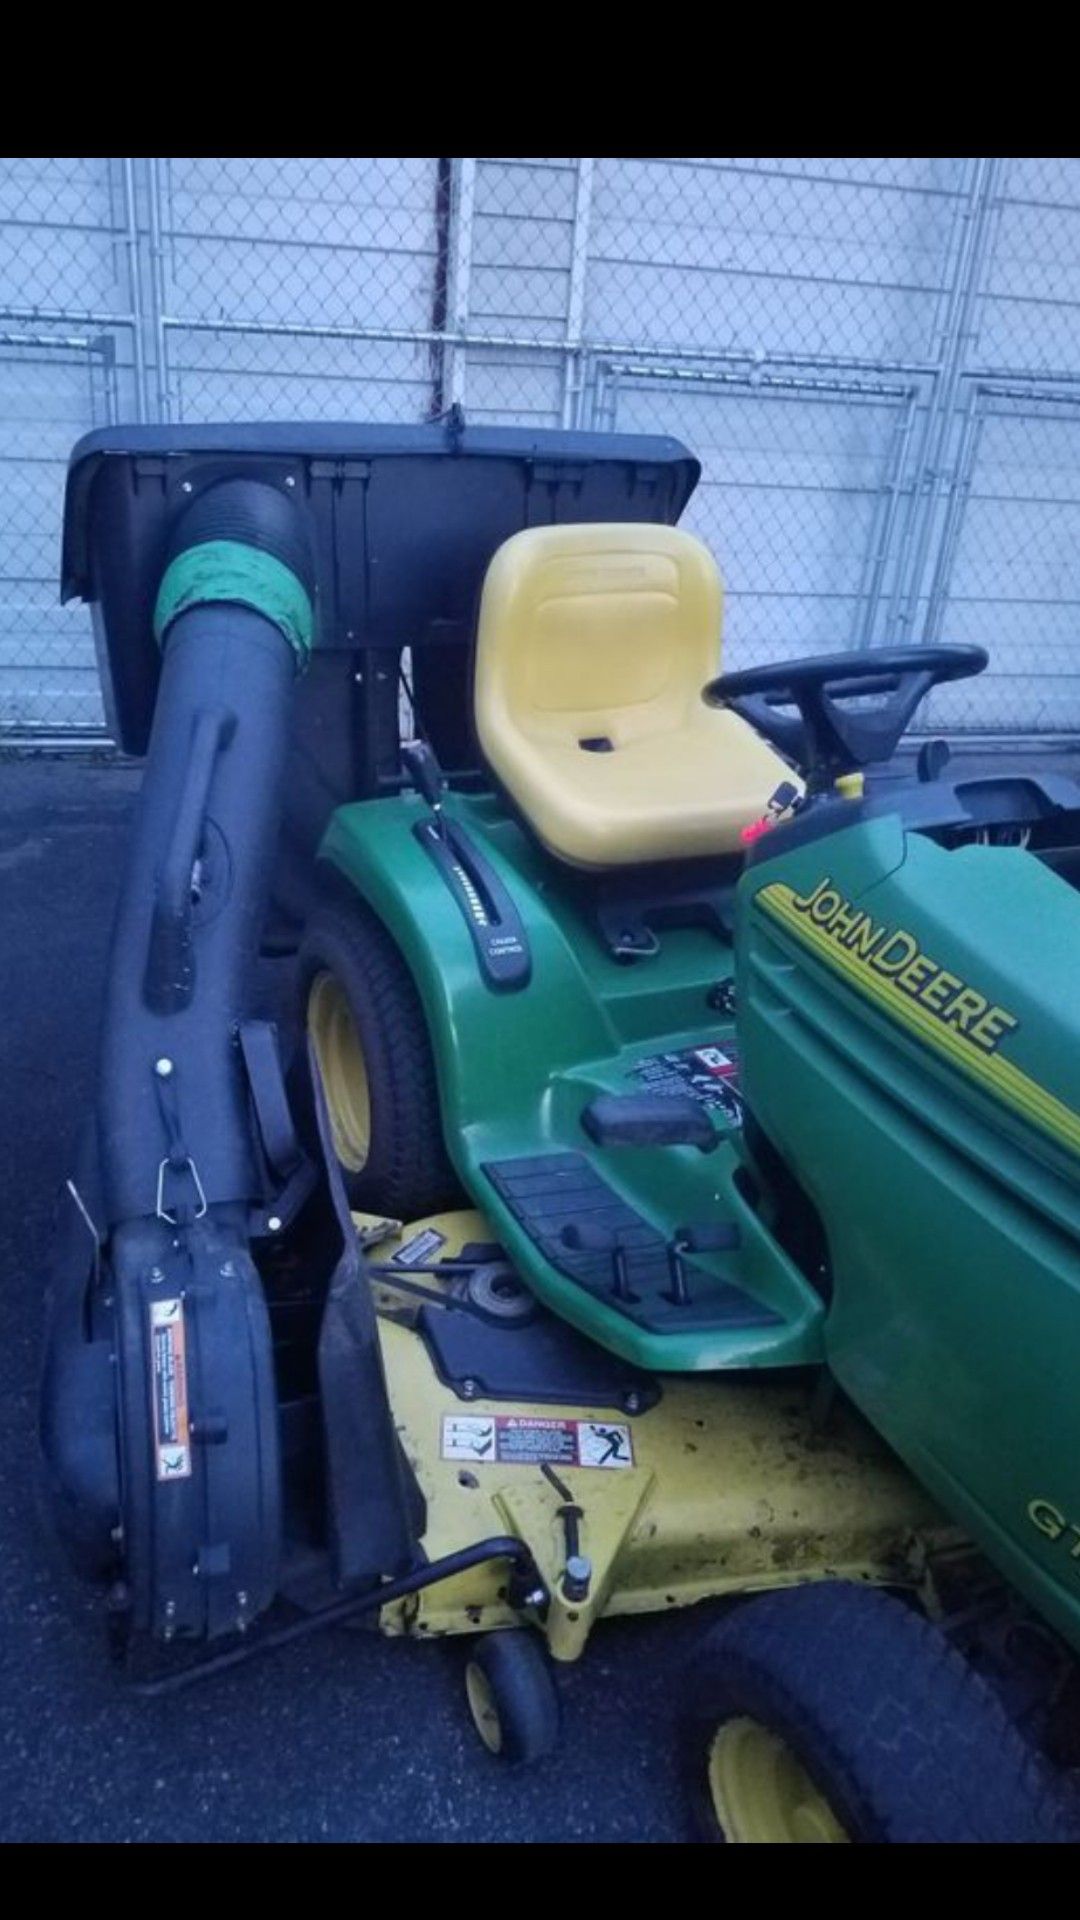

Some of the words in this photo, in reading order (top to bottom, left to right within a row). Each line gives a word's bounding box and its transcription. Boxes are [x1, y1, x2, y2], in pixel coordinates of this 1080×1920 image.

[793, 878, 886, 960] JOHN
[870, 929, 1018, 1055] DEERE
[519, 1419, 567, 1430] DANGER
